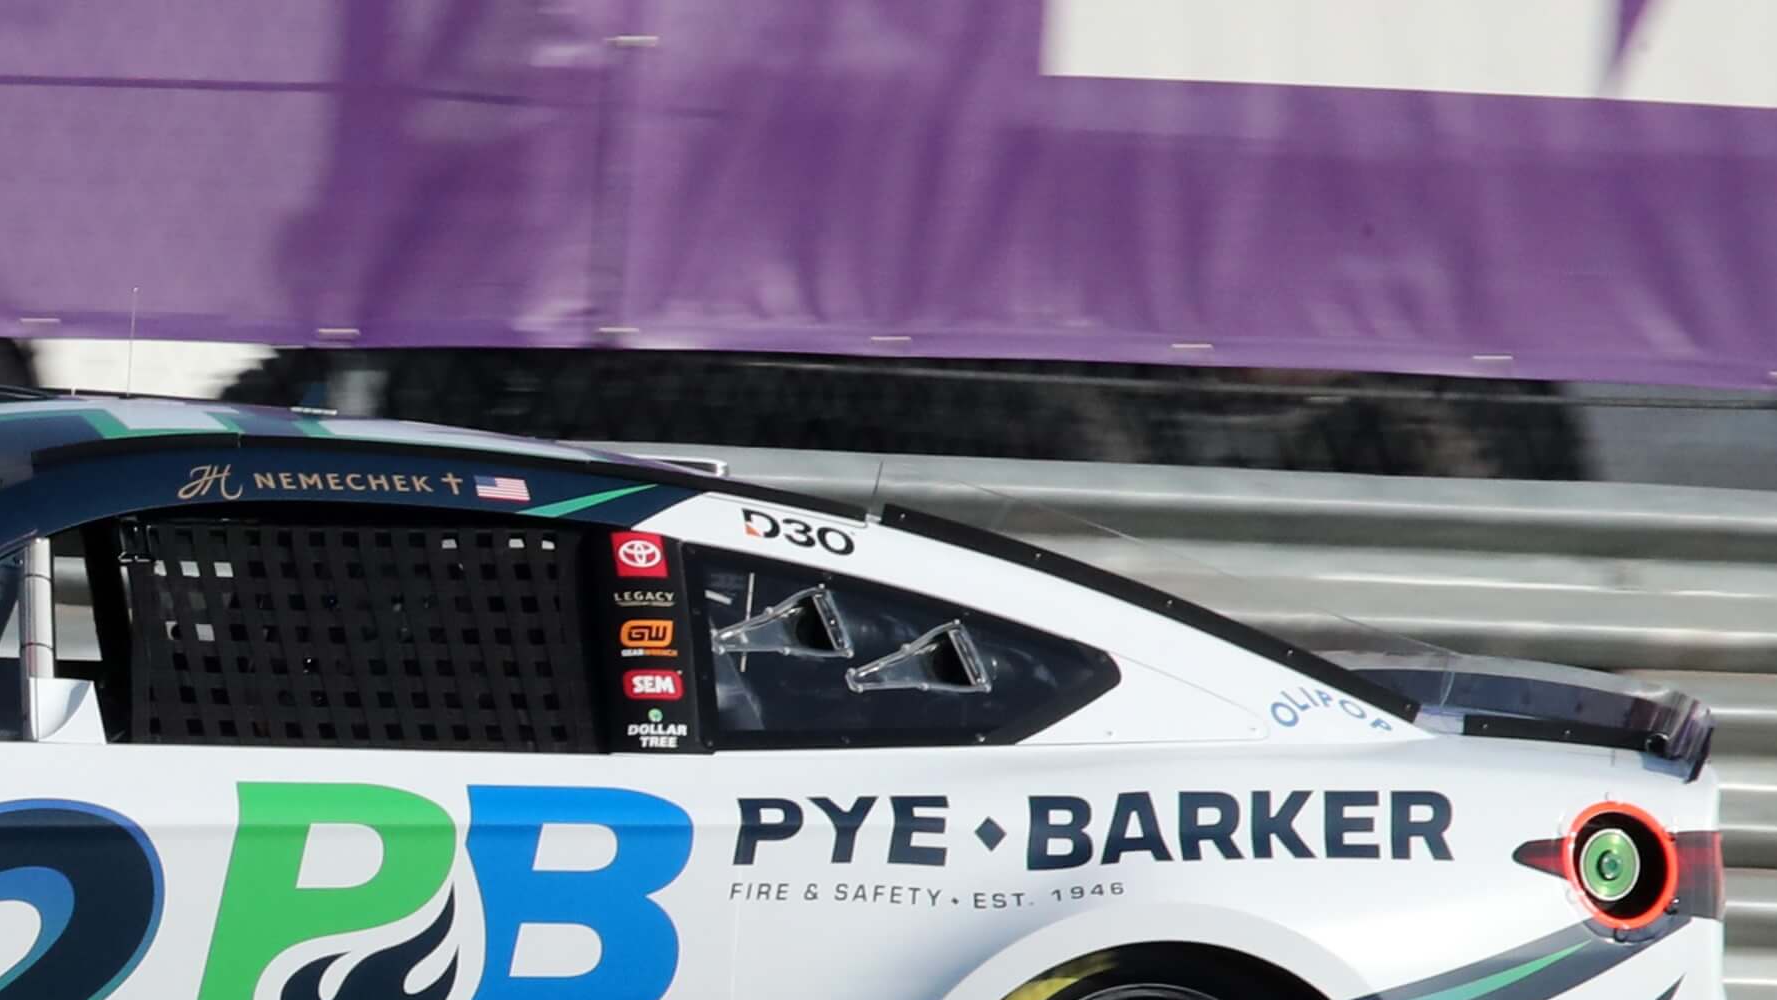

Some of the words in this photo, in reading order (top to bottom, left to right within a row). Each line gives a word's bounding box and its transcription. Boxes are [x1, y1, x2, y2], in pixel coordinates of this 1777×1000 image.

[253, 472, 434, 493] NEMECHEK
[741, 507, 855, 556] D30
[613, 591, 675, 601] LEGACY
[631, 675, 676, 694] SEM
[1270, 686, 1393, 731] OLIPOP
[627, 724, 688, 736] DOLLAR
[639, 736, 678, 748] TREE
[732, 795, 949, 866] PYE
[1026, 790, 1454, 870] BARKER
[729, 882, 790, 901] FIRE
[803, 883, 819, 901] &
[834, 883, 942, 907] SAFETY
[973, 892, 1035, 909] EST.
[1051, 882, 1125, 902] 1946
